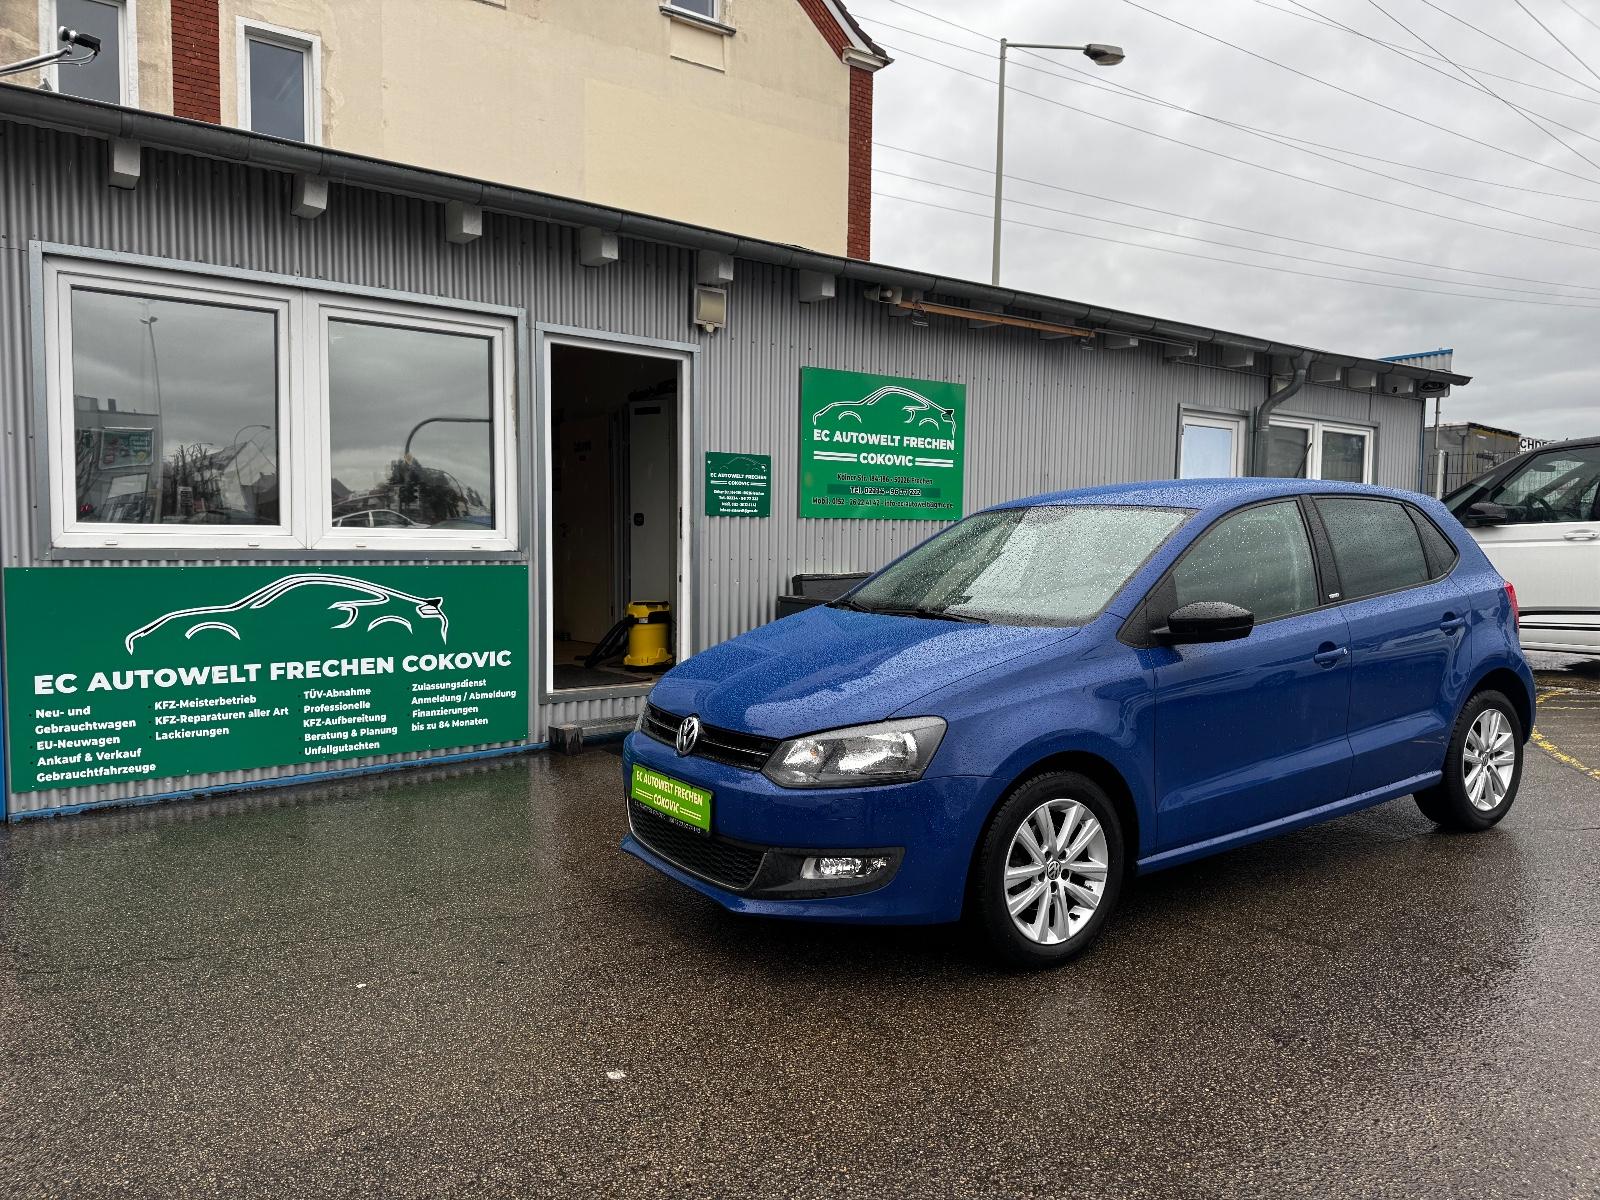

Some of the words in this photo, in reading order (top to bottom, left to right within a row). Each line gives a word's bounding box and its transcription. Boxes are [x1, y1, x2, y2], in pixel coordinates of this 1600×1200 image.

[813, 429, 830, 442] EC
[833, 431, 901, 446] AUTOWELT
[903, 436, 955, 450] FRECHEN
[859, 453, 913, 467] COKOVIC
[850, 486, 863, 495] Tel.
[34, 673, 78, 695] EC
[87, 663, 262, 692] AUTOWELT
[270, 656, 394, 681] FRECHEN
[402, 650, 512, 673] COKOVIC
[411, 678, 487, 692] Zulassungsdienst
[303, 687, 371, 700] TÜV-Abnahme
[411, 692, 461, 706] Anmeldung
[469, 689, 517, 702] Abmeldung
[154, 695, 257, 710] KFZ-Meisterbetrieb
[303, 701, 371, 714] Professionelle
[35, 708, 64, 719] Neu-
[67, 706, 91, 717] und
[155, 710, 246, 726] KFZ-Reparaturen
[248, 708, 271, 719] aller
[273, 707, 289, 717] Art
[412, 705, 479, 718] Finanzierungen
[35, 719, 137, 735] Gebrauchtwagen
[303, 713, 387, 728] KFZ-Aufbereitung
[411, 722, 425, 731] bis
[427, 722, 437, 730] zu
[439, 720, 450, 729] 84
[452, 717, 489, 728] Monaten
[155, 726, 230, 741] Lackierungen
[304, 729, 348, 742] Beratung
[350, 728, 358, 737] &
[360, 725, 398, 739] Planung
[36, 736, 121, 750] EU-Neuwagen
[304, 741, 380, 756] Unfallgutachten
[37, 753, 81, 767] Ankauf
[84, 753, 93, 762] &
[96, 748, 142, 762] Verkauf
[36, 763, 157, 783] Gebrauchtfahrzeuge
[636, 771, 643, 782] EC
[643, 773, 673, 795] AUTOWELT
[674, 785, 703, 806] FRECHEN
[653, 794, 680, 813] COKOVIC
